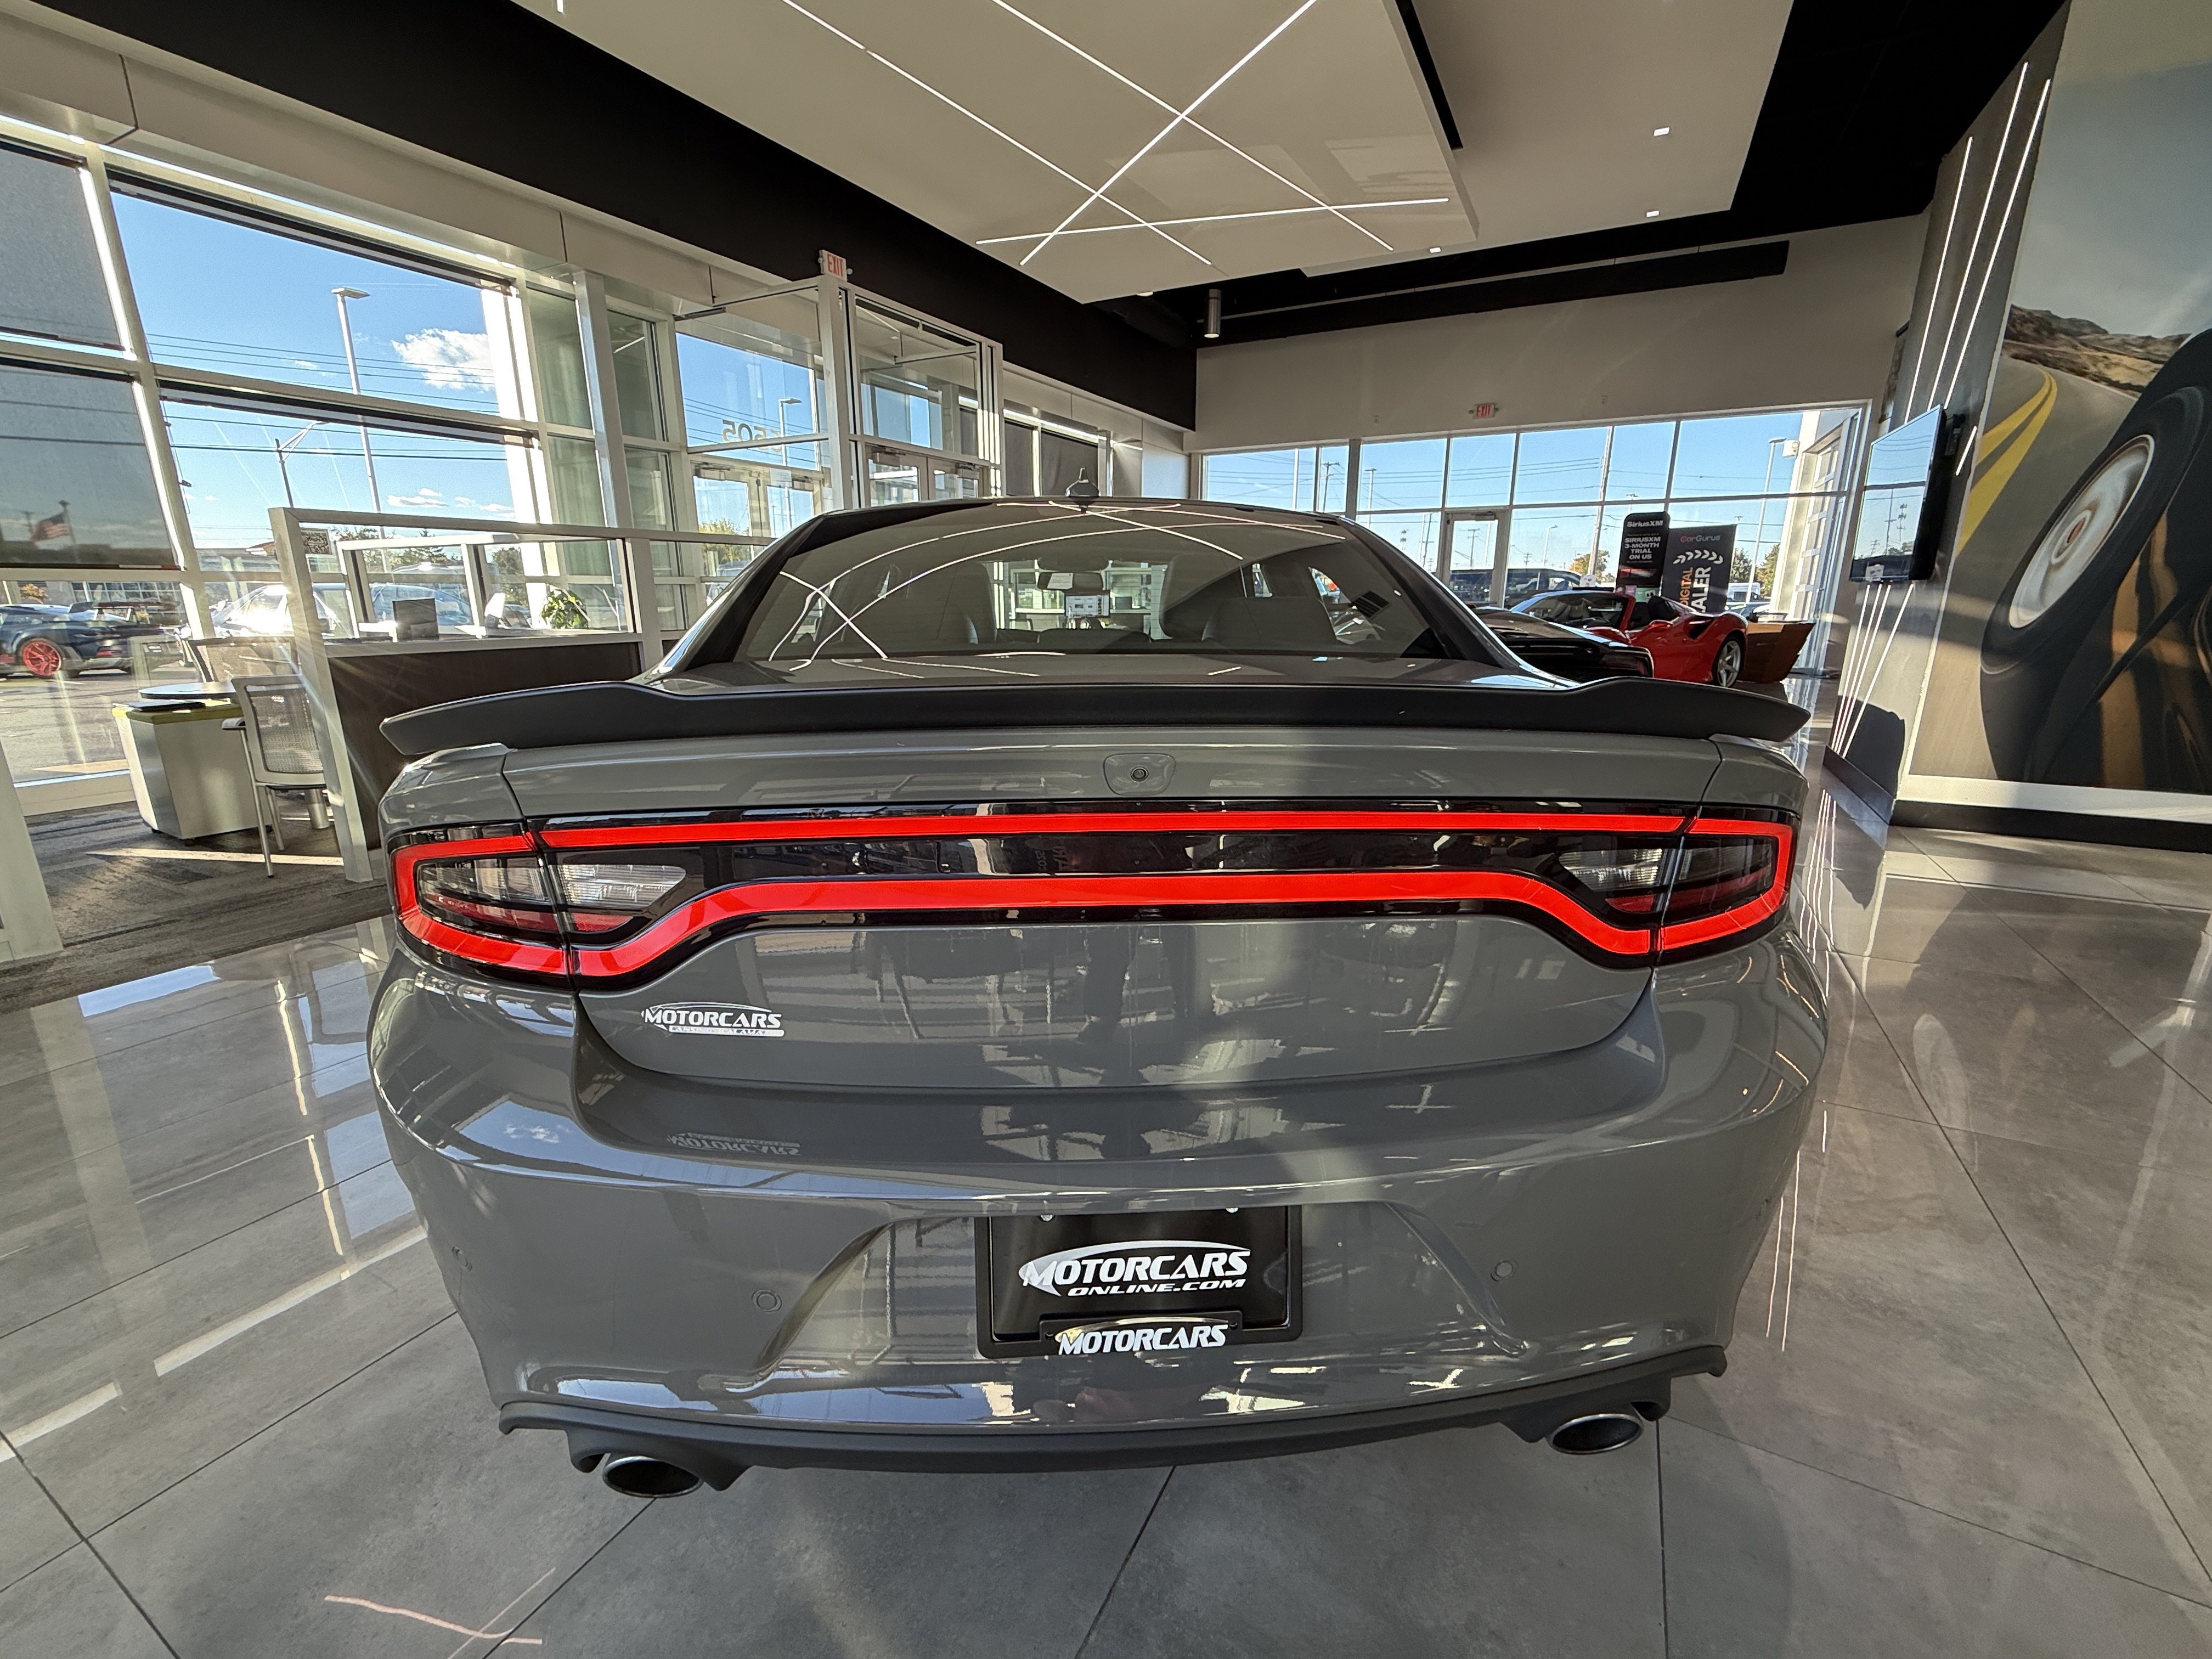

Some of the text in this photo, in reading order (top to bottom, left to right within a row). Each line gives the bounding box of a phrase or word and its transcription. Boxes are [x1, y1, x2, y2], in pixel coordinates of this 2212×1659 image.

[827, 253, 843, 277] EXIT
[1476, 405, 1492, 417] EXIT
[1680, 534, 1720, 543] CarGurus
[645, 1008, 782, 1028] MOTORCARS
[1023, 1251, 1251, 1286] MOTORCARS
[1067, 1279, 1246, 1296] ONLINE.COM
[1059, 1324, 1228, 1355] MOTORCARS
